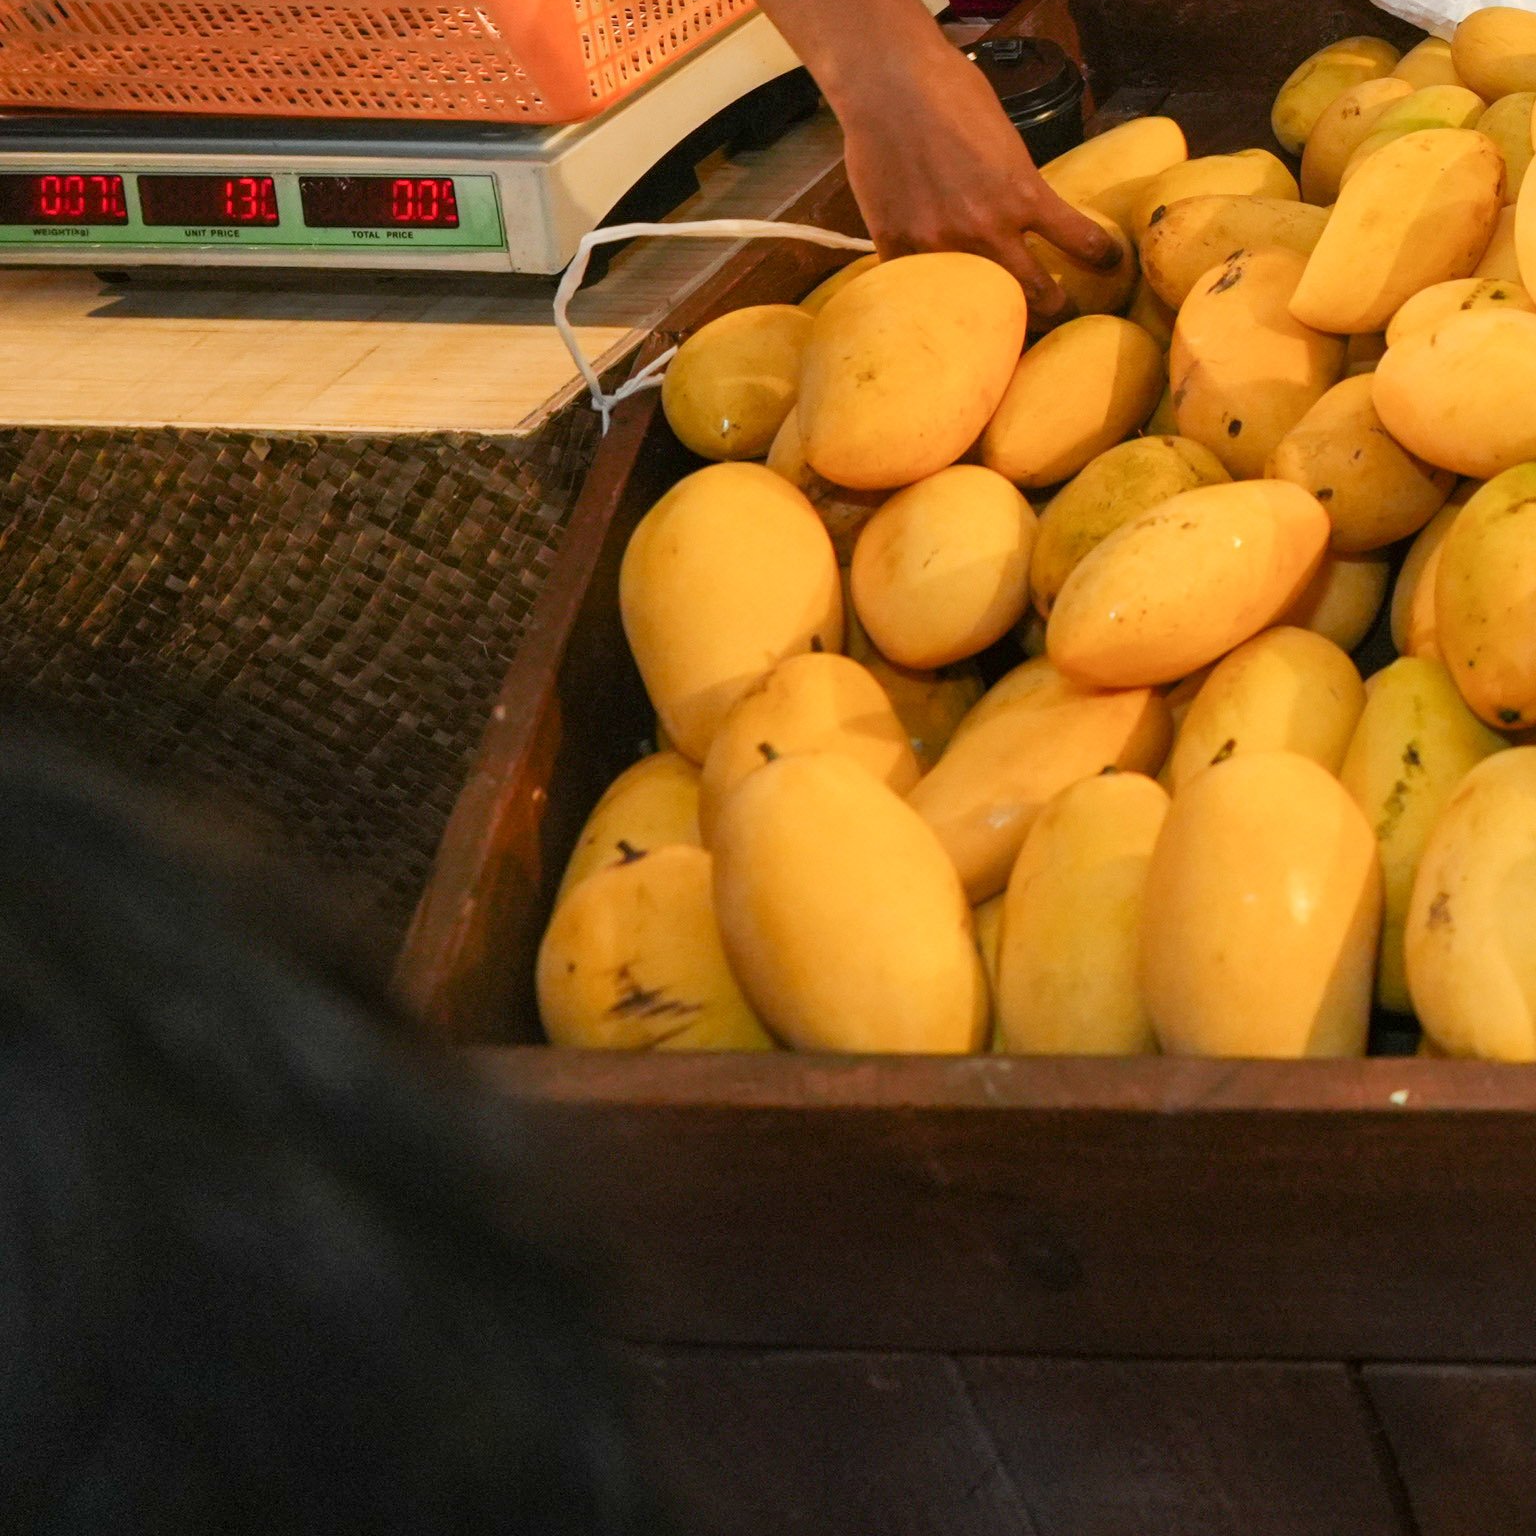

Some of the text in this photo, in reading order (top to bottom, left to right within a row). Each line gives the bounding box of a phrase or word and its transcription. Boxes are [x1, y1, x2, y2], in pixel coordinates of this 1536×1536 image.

[185, 229, 240, 238] UNIT PRICE
[352, 230, 414, 239] TOTAL PRICE
